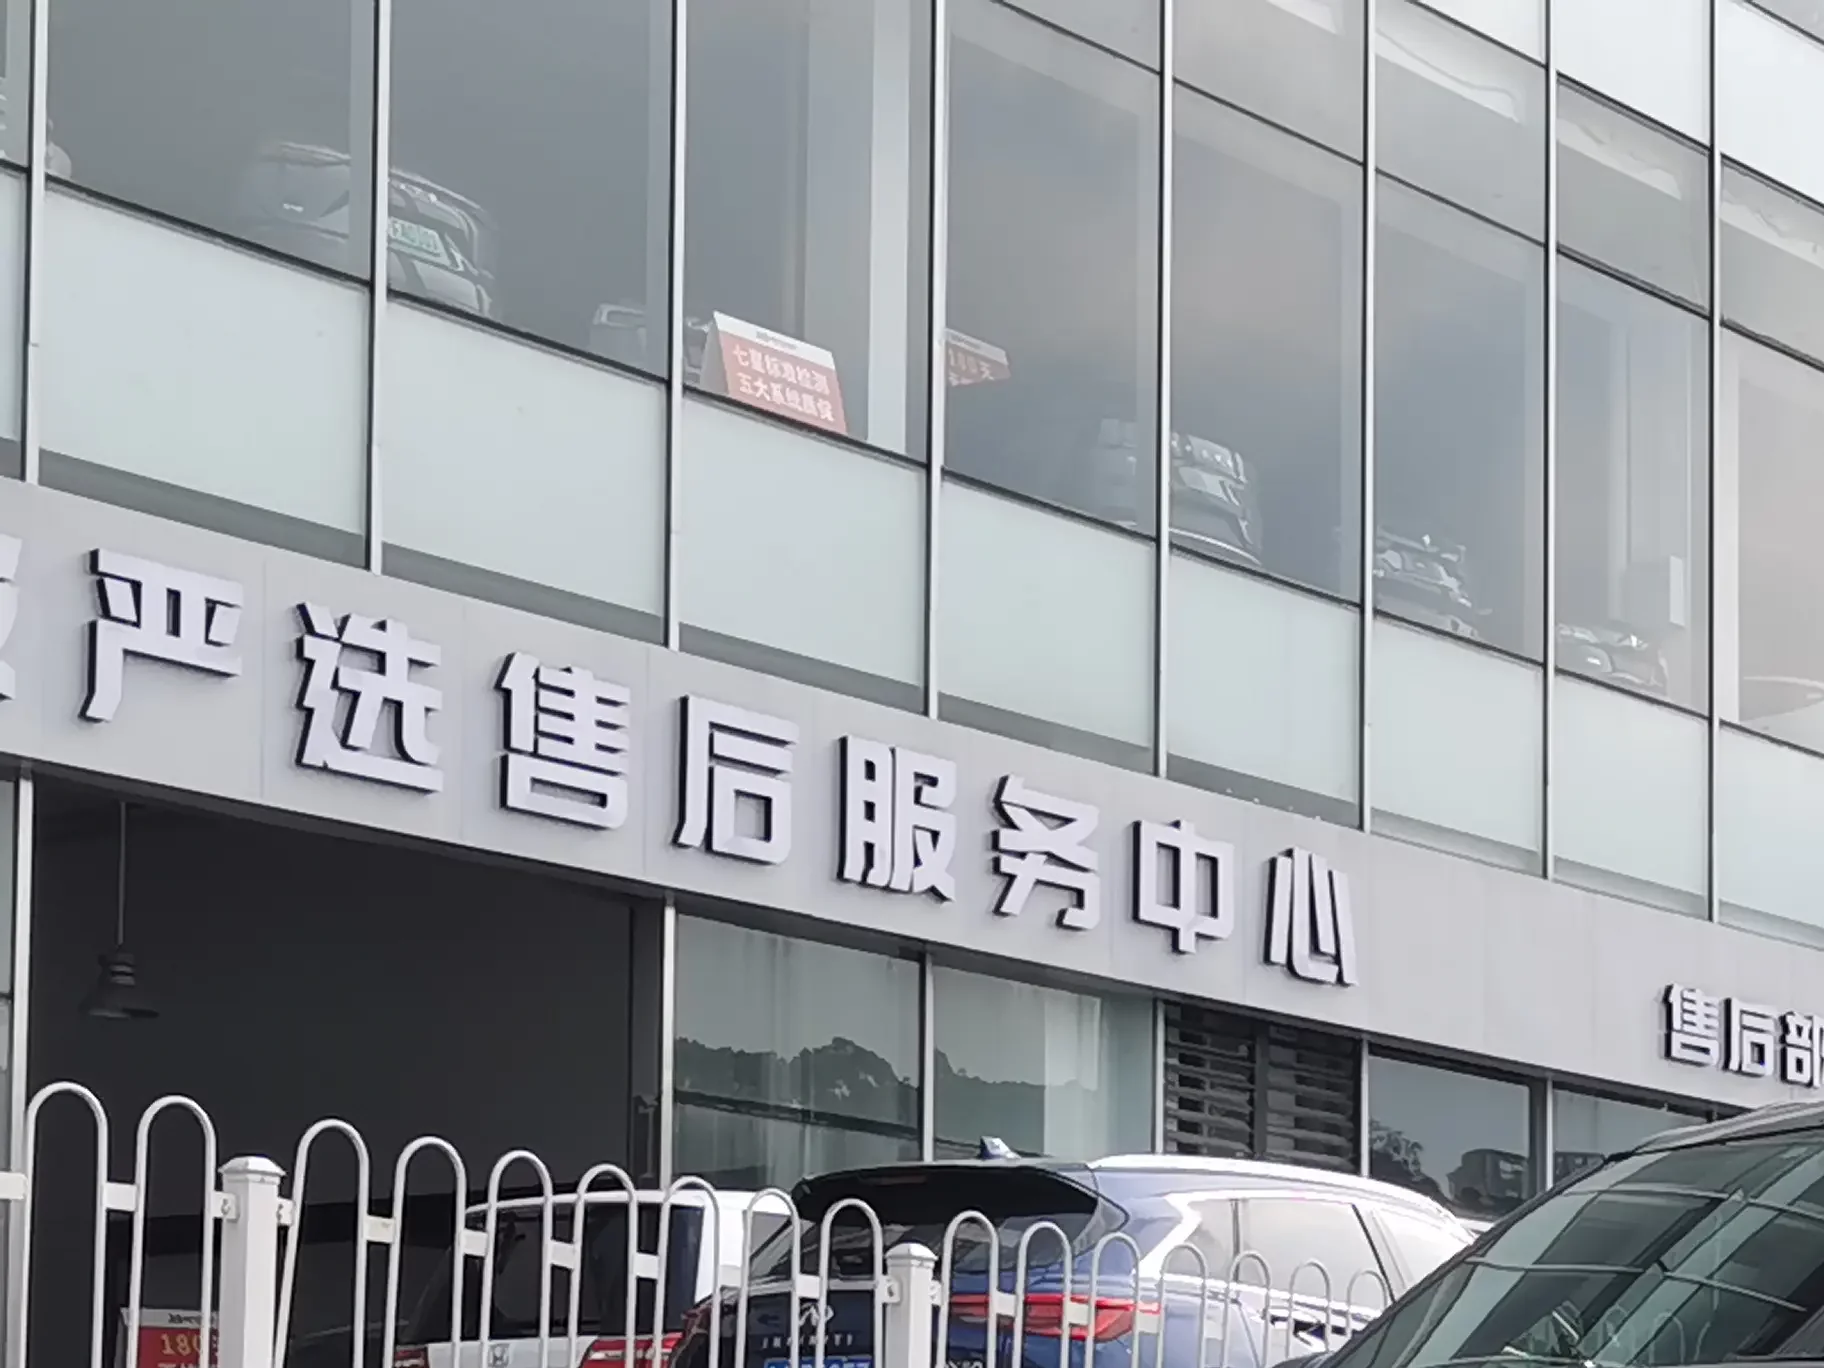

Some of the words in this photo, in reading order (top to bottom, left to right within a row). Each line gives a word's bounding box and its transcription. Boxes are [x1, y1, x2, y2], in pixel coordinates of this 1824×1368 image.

[0, 533, 1359, 987] 严选售后服务中心
